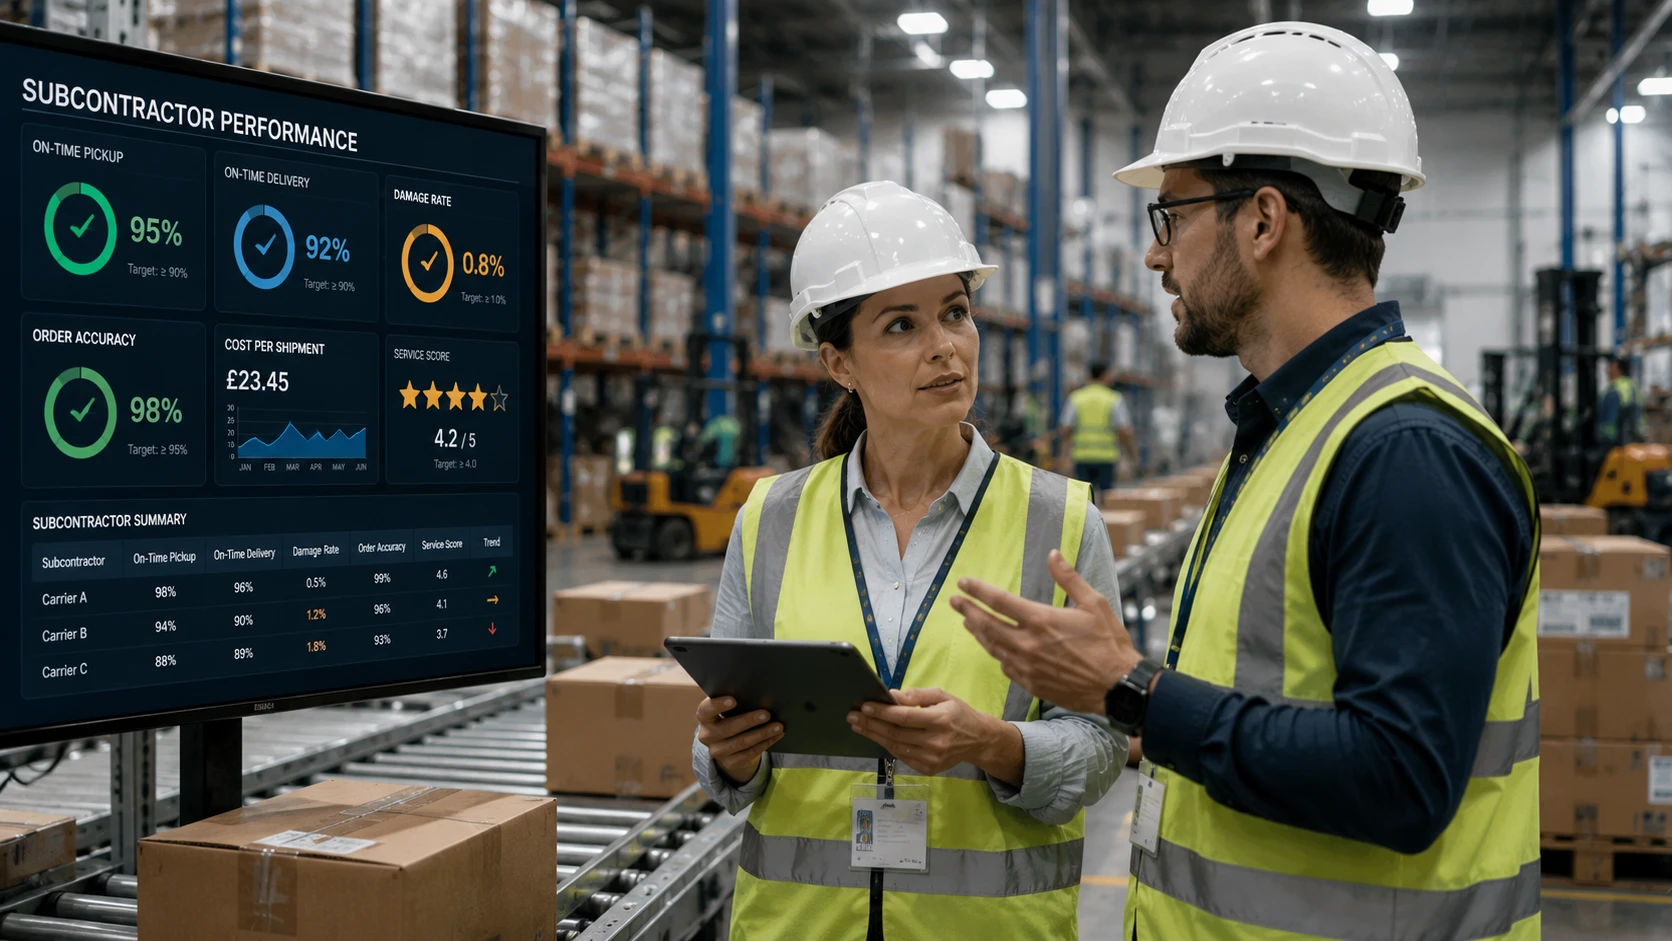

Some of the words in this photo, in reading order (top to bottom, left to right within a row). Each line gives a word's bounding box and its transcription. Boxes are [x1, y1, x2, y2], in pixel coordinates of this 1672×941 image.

[23, 78, 214, 129] SUBCONTRACTOR
[221, 111, 357, 152] PERFORMANCE
[33, 140, 80, 157] ON-TIME
[84, 147, 123, 162] PICKUP
[225, 167, 264, 182] ON-TIME
[268, 172, 310, 188] DELIVERY
[394, 189, 429, 203] DAMAGE
[431, 194, 451, 206] RATE
[131, 216, 182, 246] 95%
[306, 235, 350, 262] 92%
[128, 263, 158, 277] Target:
[169, 267, 188, 278] 90%
[463, 252, 504, 277] 0.8%
[304, 278, 329, 291] Target:
[338, 281, 355, 291] 90%
[461, 292, 483, 304] Target:
[33, 329, 72, 343] ORDER
[75, 332, 136, 346] ACCURACY
[225, 339, 252, 350] COST
[255, 340, 273, 352] PER
[276, 342, 325, 354] SHIPMENT
[394, 349, 424, 360] SERVICE
[426, 351, 450, 361] SCORE
[226, 369, 288, 391] £23.45
[131, 397, 182, 423] 98%
[227, 429, 234, 437] 20
[435, 429, 457, 447] 4.2
[128, 444, 158, 457] Target:
[169, 444, 188, 455] 95%
[264, 463, 275, 471] FEB
[434, 459, 457, 471] Target:
[464, 459, 476, 468] 4.0
[33, 515, 131, 529] SUBCONTRACTOR
[134, 513, 186, 526] SUMMARY
[42, 556, 105, 568] Subcontractor
[134, 553, 168, 564] On-Time
[170, 551, 196, 563] Pickup
[214, 549, 245, 560] On-Time
[247, 548, 275, 559] Delivery
[293, 546, 322, 557] Damage
[324, 545, 339, 554] Rate
[358, 543, 375, 552] Order
[377, 543, 406, 553] Accuracy
[422, 540, 444, 550] Service
[445, 540, 463, 548] Score
[484, 537, 500, 547] Trend
[42, 593, 77, 605] Carrier
[80, 592, 87, 603] A
[155, 586, 176, 598] 98%
[234, 582, 253, 593] 96%
[306, 577, 326, 588] 0.5%
[374, 573, 391, 583] 99%
[437, 569, 447, 579] 4.6
[42, 629, 77, 642] Carrier
[80, 627, 87, 638] B
[155, 621, 176, 632] 94%
[234, 615, 253, 626] 90%
[307, 609, 326, 620] 1.2%
[374, 604, 391, 614] 96%
[436, 599, 446, 608] 4.1
[43, 665, 77, 678] Carrier
[80, 663, 87, 674] C
[155, 655, 176, 667] 88%
[234, 648, 253, 659] 89%
[307, 641, 326, 652] 1.8%
[374, 634, 391, 645] 93%
[437, 629, 447, 639] 3.7
